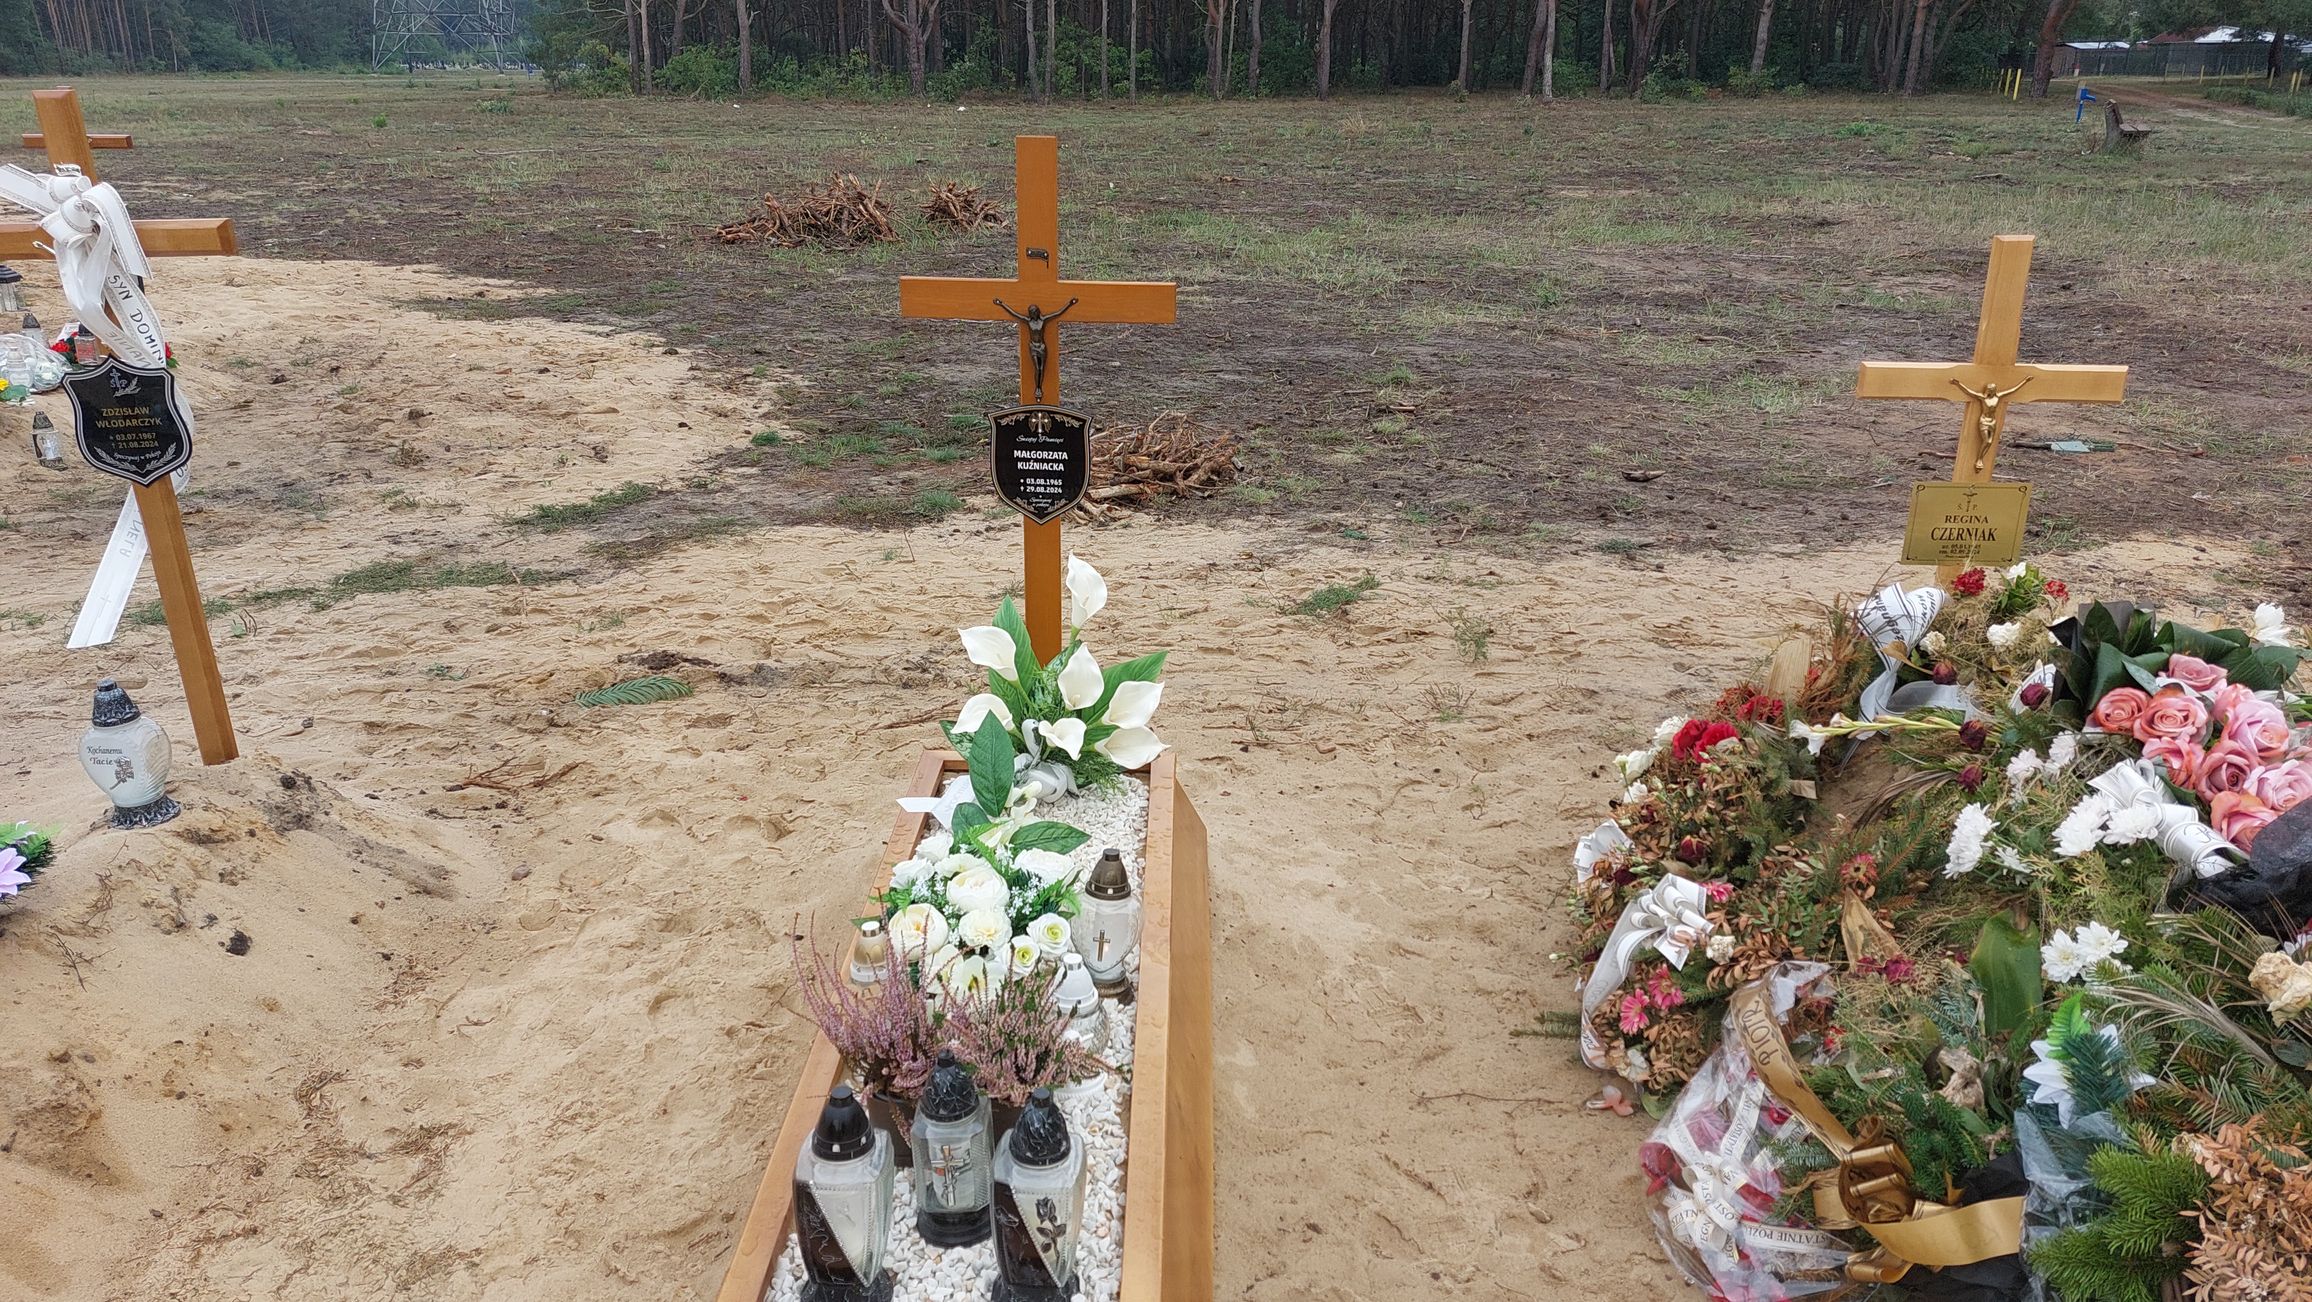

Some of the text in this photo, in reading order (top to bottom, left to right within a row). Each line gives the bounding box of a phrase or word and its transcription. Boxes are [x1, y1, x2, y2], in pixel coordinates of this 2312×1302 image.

[108, 274, 164, 364] SYN DOMIN
[101, 406, 150, 417] ZDZISŁAW
[95, 417, 163, 429] WŁODARCZYK
[115, 432, 156, 441] 03.07.1967
[118, 441, 159, 449] 21.08.2024
[1013, 449, 1069, 460] MAŁGORZATA
[1017, 460, 1065, 472] KUŹNIACKA
[1944, 514, 1989, 524] REGINA
[1930, 527, 1998, 542] CZERNIAK
[1742, 1000, 1779, 1066] PIOTR
